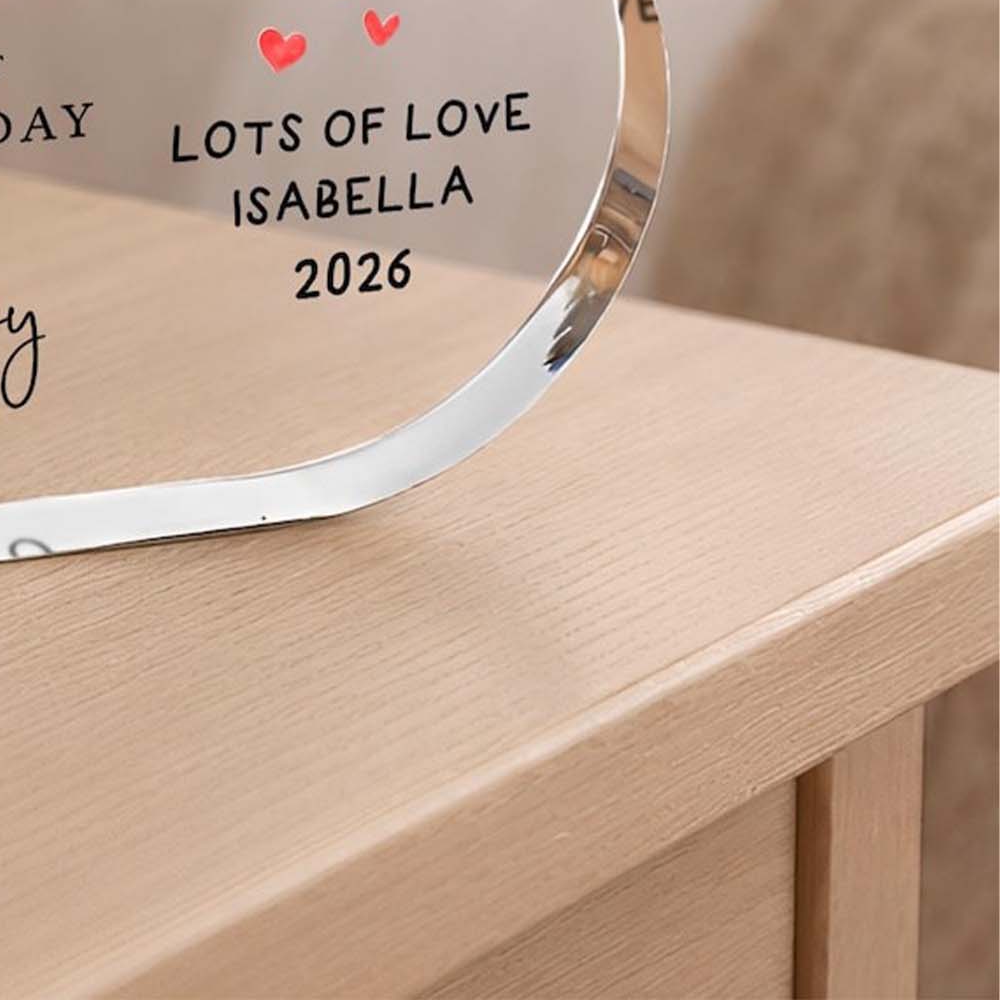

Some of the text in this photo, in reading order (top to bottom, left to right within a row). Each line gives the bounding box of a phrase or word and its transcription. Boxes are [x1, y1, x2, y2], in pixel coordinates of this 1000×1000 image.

[172, 92, 531, 163] LOTS OF LOVE
[233, 165, 474, 227] ISABELLA
[294, 248, 411, 300] 2026
